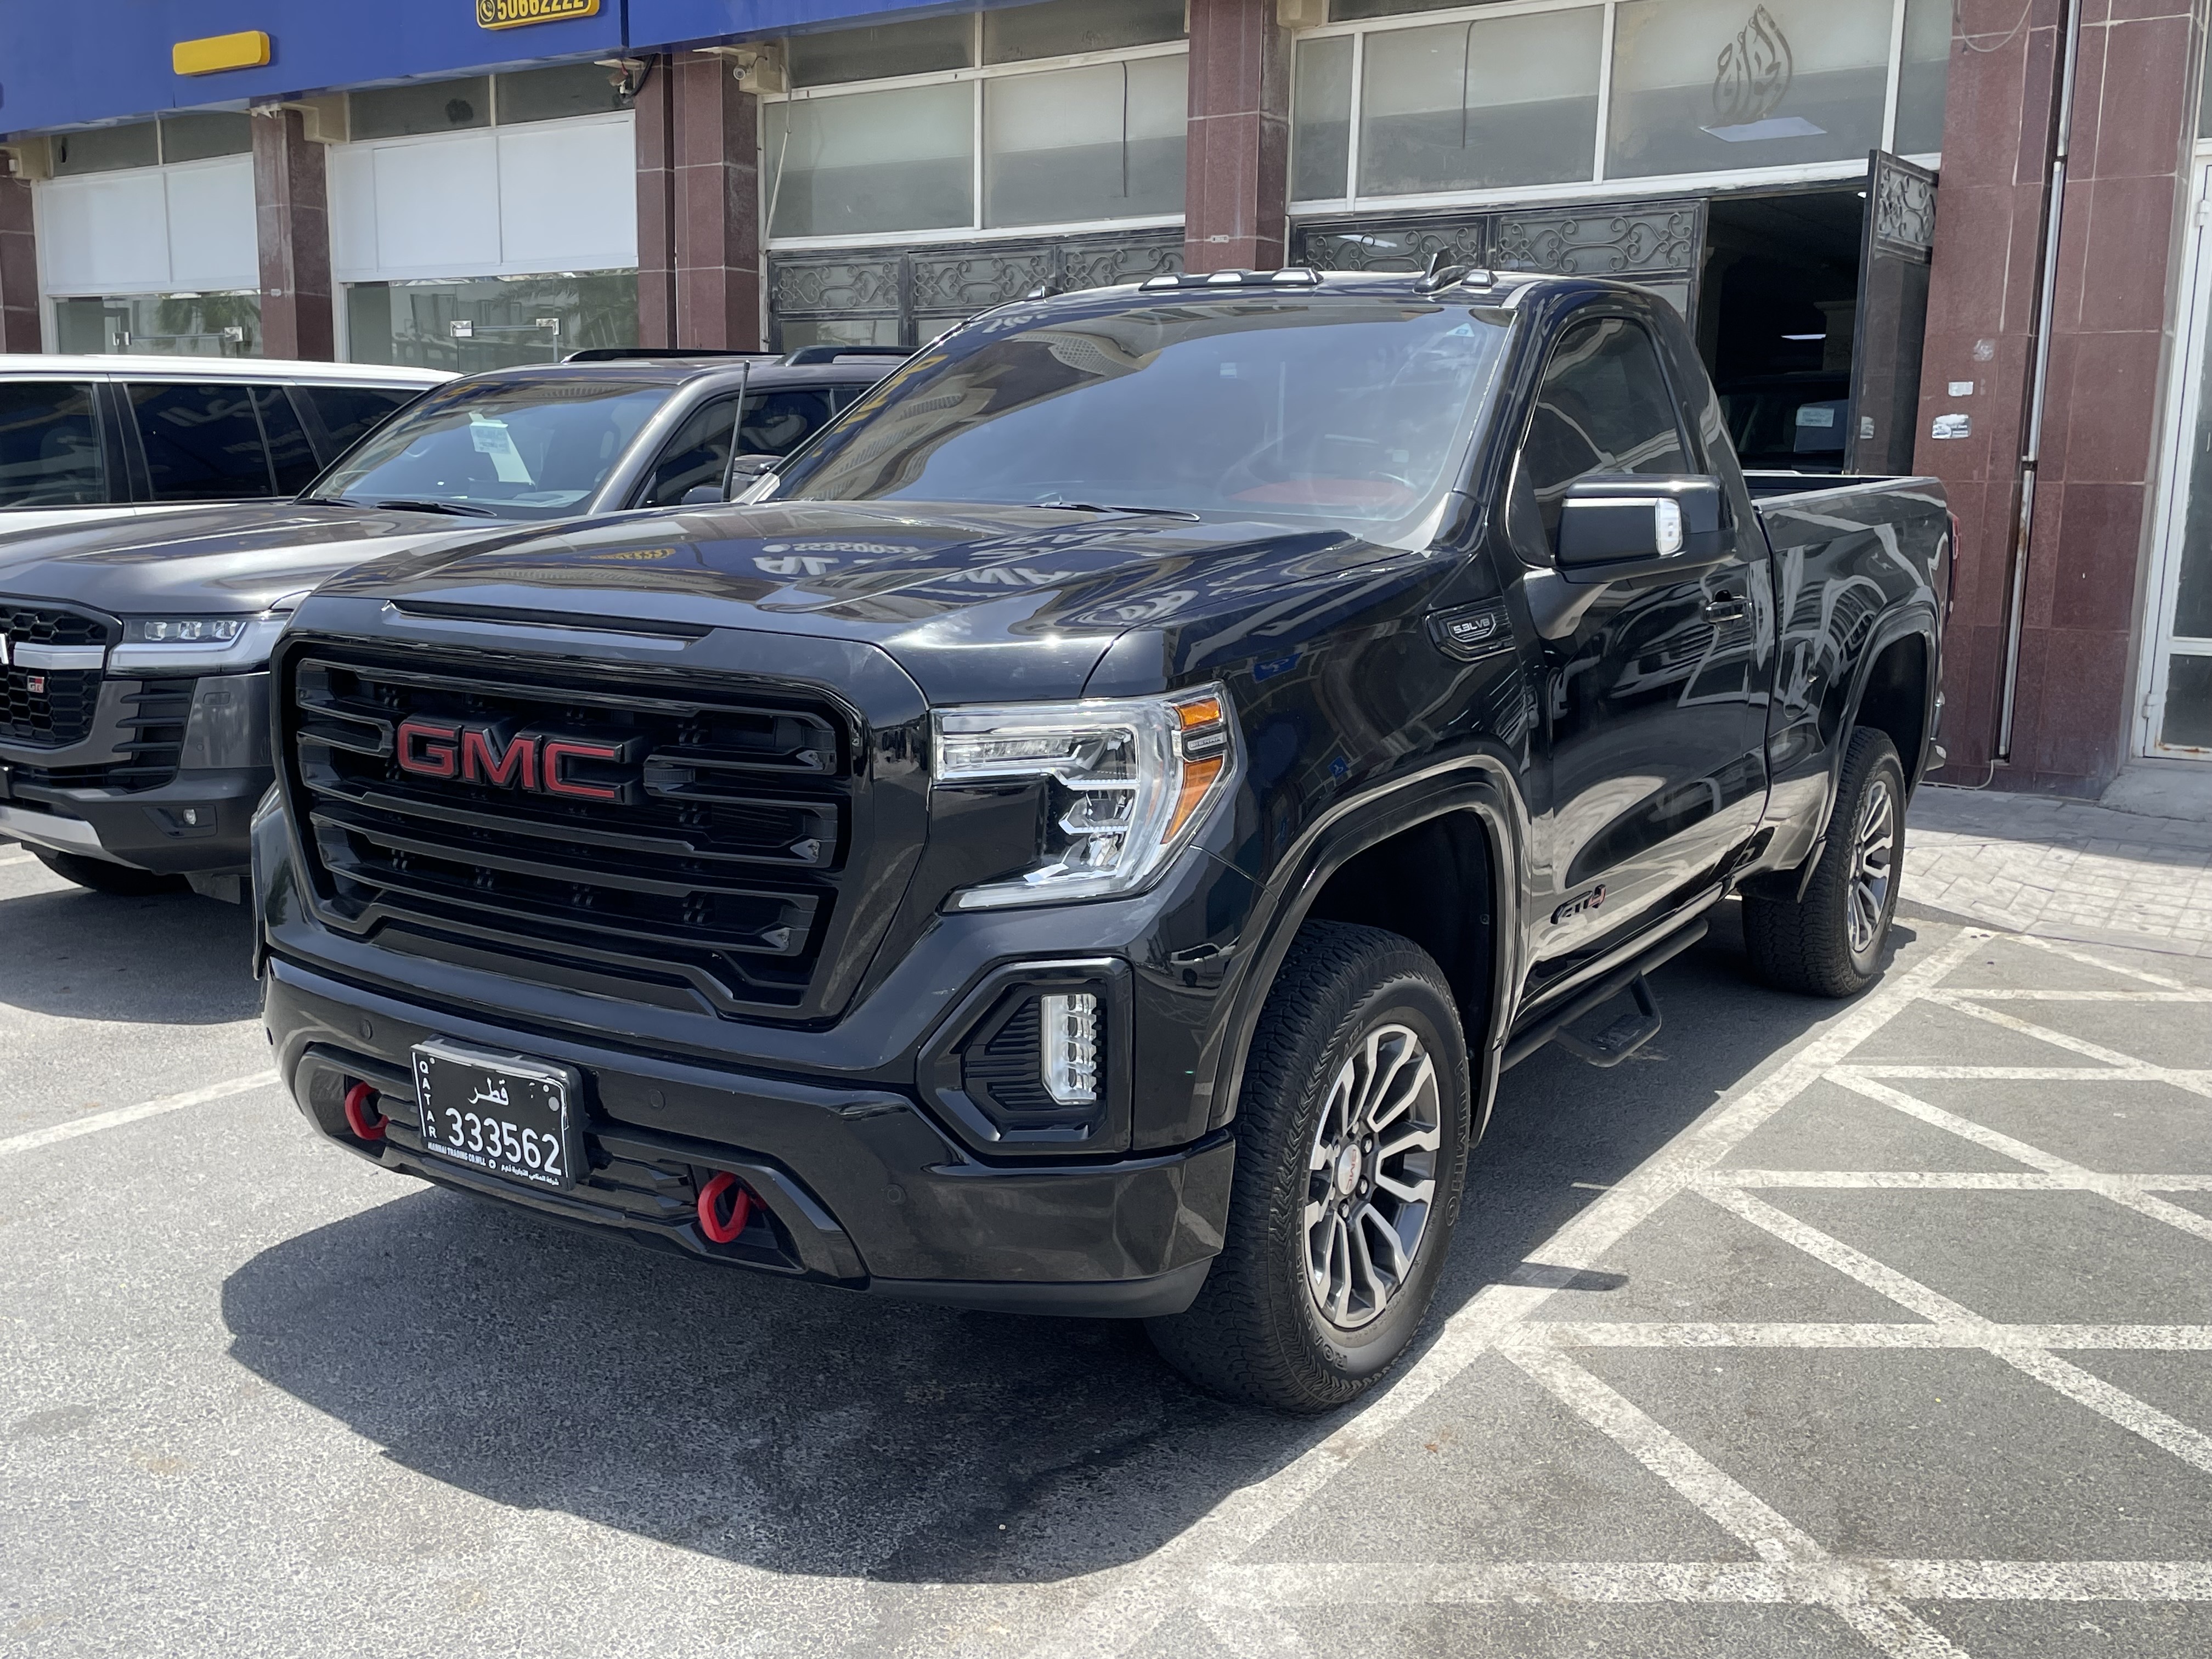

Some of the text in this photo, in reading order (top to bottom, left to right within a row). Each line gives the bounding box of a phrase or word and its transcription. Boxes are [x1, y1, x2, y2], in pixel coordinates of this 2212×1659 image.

[397, 720, 624, 802] GMC
[419, 1060, 437, 1138] QATAR
[467, 1077, 509, 1105] قطر
[445, 1107, 562, 1176] 333562
[1346, 1148, 1357, 1190] GMC
